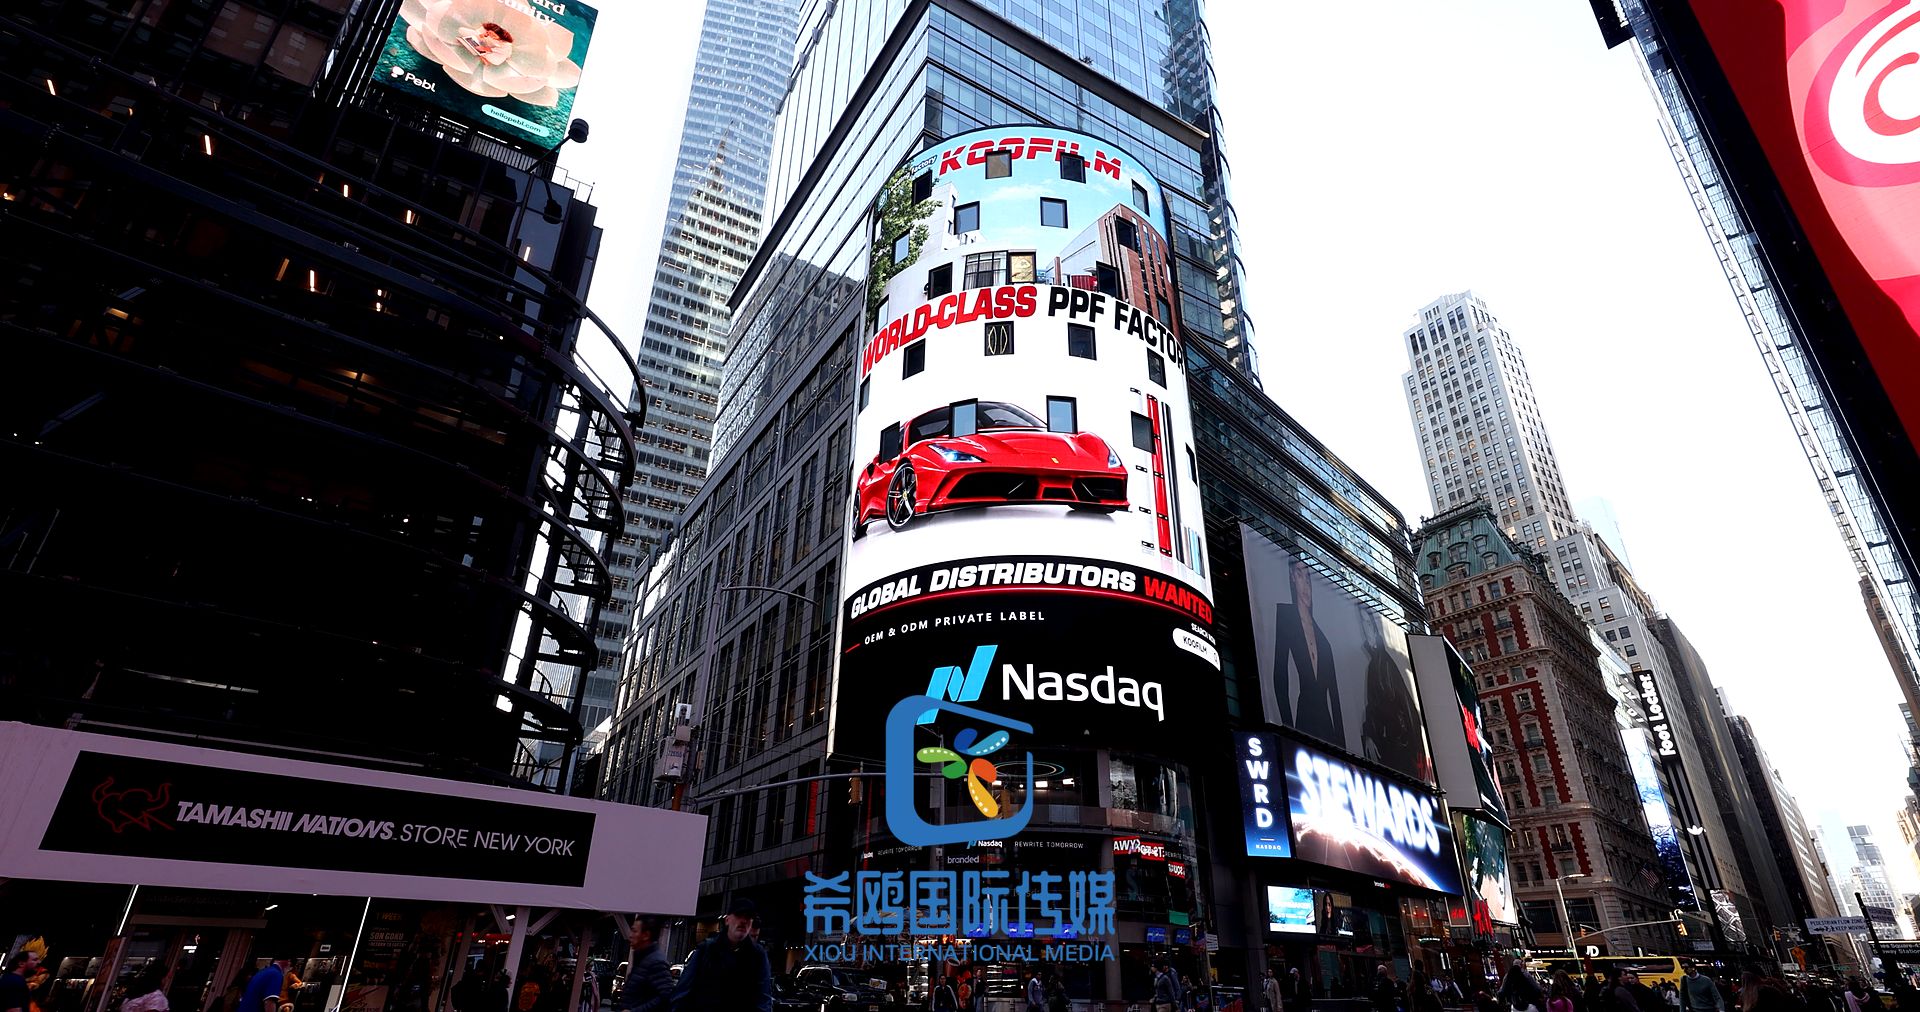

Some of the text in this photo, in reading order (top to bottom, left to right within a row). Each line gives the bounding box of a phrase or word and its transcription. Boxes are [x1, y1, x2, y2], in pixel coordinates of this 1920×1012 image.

[404, 72, 436, 93] Pebl
[490, 108, 542, 134] hellopebl.com
[939, 137, 1122, 181] KOOFILM
[861, 285, 1037, 379] WORLD-CLASS
[1048, 285, 1106, 323] PPF
[851, 562, 1213, 625] GLOBAL DISTRIBUTORS WANTED
[864, 611, 1045, 645] OEM & ODM PRIVATE LABEL
[1002, 663, 1165, 722] Nasdaq
[1639, 673, 1677, 756] Foot Locker
[176, 801, 576, 857] TAMASHII NATIONS STORE NEW YORK
[977, 839, 1004, 849] Nasdaq
[1014, 840, 1085, 849] REWRITE TOMORROW
[947, 853, 980, 865] branded
